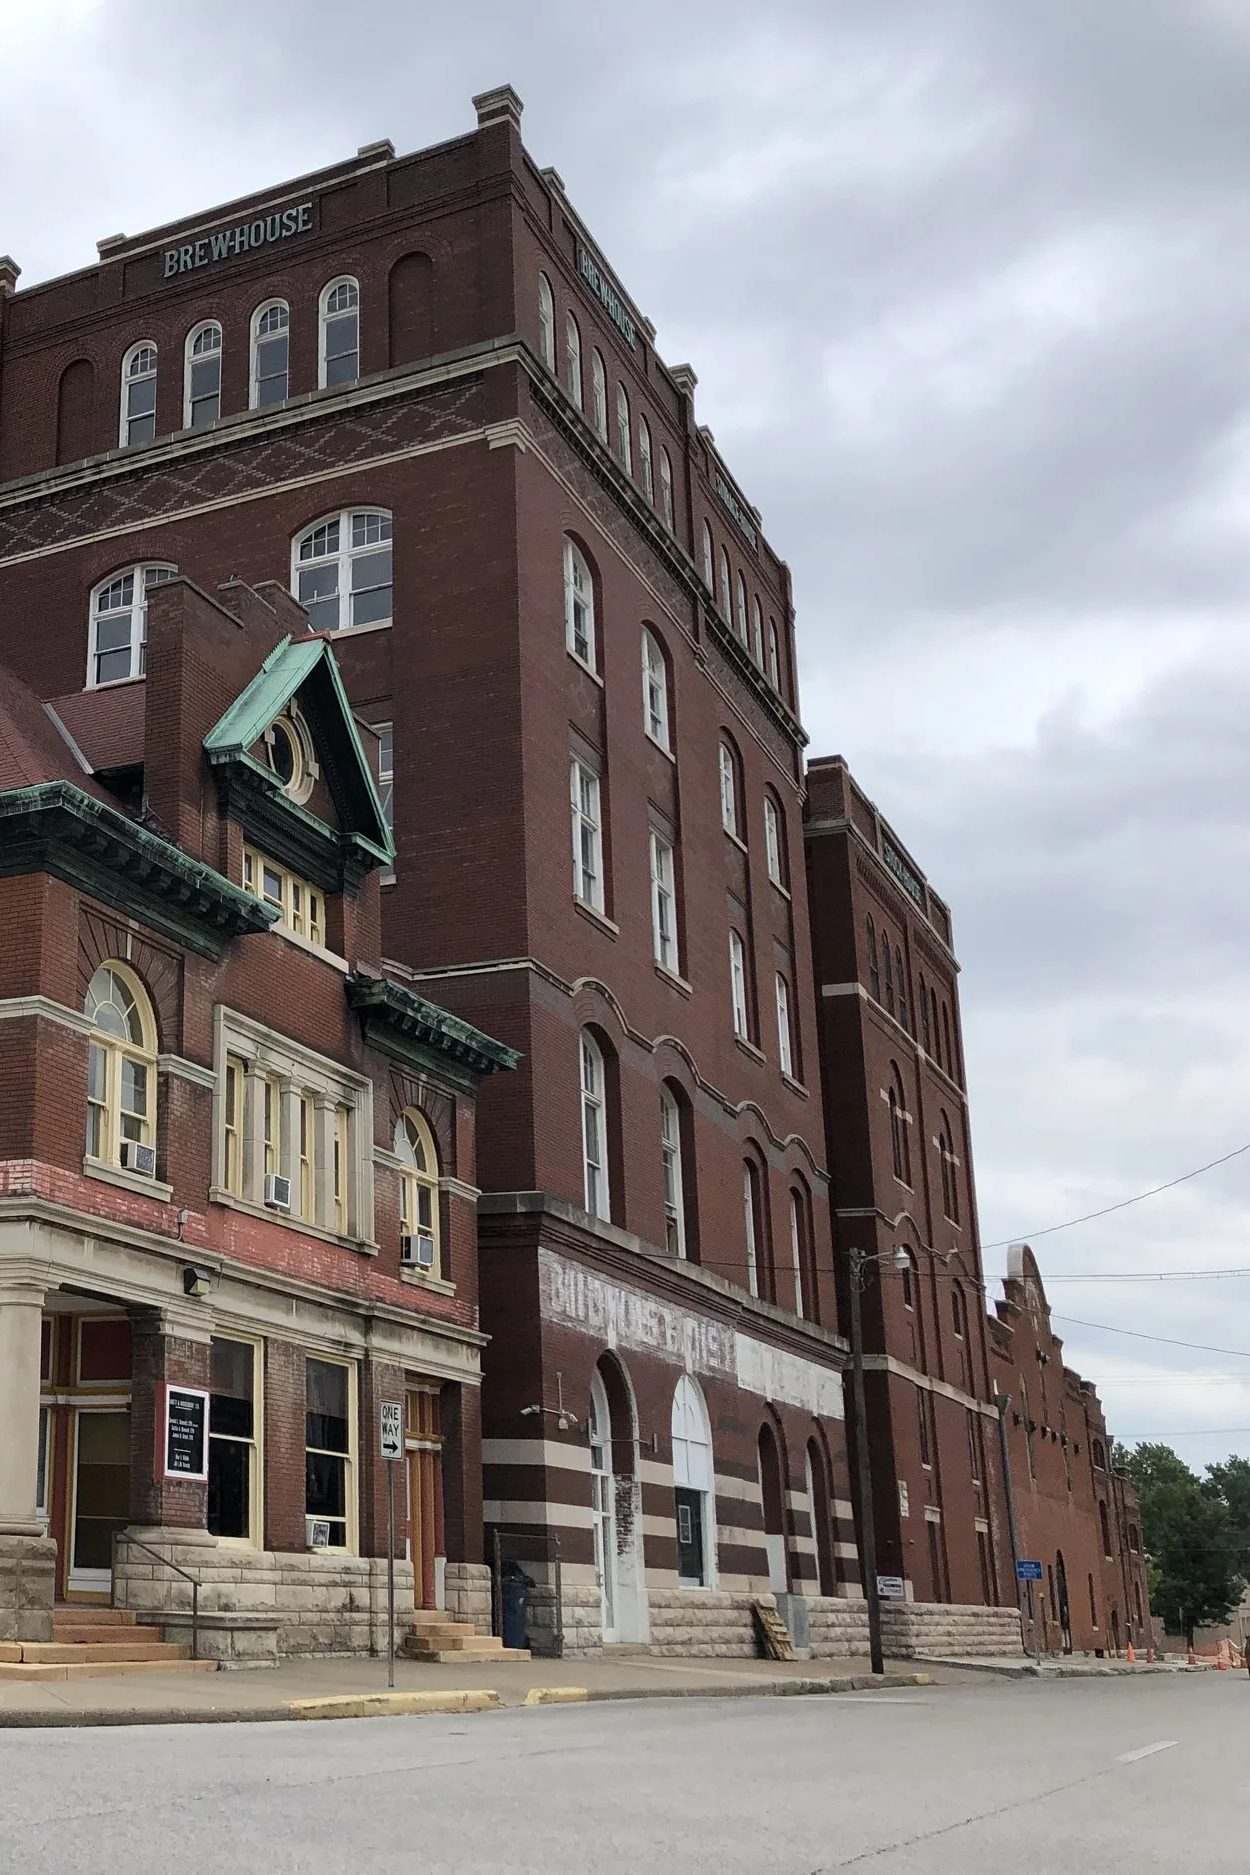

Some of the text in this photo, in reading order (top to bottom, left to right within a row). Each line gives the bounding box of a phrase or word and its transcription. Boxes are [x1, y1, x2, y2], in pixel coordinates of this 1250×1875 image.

[163, 201, 313, 278] BREW-HOUSE
[580, 248, 637, 352] BREW-HOUSE
[382, 1405, 399, 1421] ONE
[382, 1422, 400, 1437] WAY
